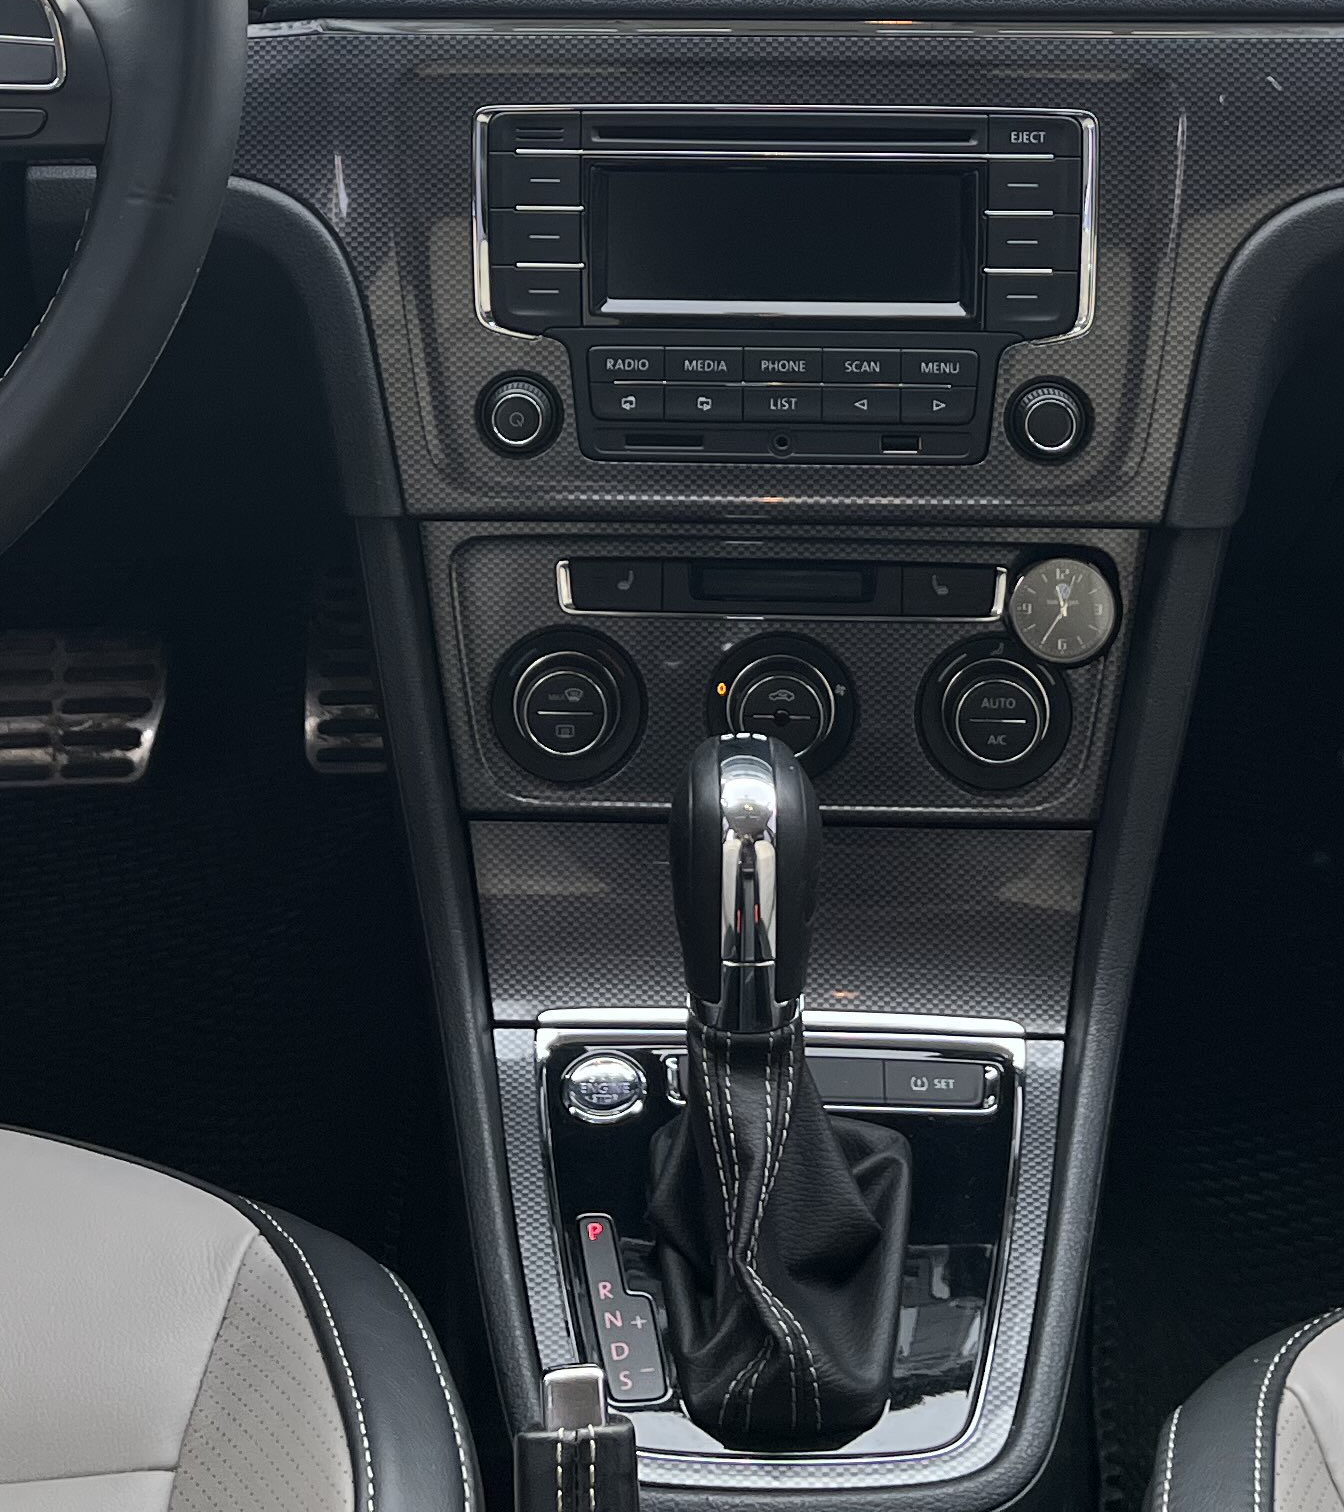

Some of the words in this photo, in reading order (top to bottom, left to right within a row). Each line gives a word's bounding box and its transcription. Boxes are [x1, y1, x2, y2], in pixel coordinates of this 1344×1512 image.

[1010, 131, 1046, 144] EJECT
[606, 358, 649, 371] RADIO
[684, 360, 728, 373] MEDIA
[760, 360, 806, 373] PHONE
[844, 361, 881, 374] SCAN
[920, 361, 960, 374] MENU
[770, 398, 798, 411] LIST
[981, 697, 1016, 709] AUTO
[987, 734, 1007, 745] A/C
[933, 1078, 955, 1089] SET
[587, 1222, 602, 1240] P
[598, 1281, 614, 1300] R
[604, 1310, 622, 1329] N
[610, 1342, 629, 1361] D
[619, 1370, 632, 1390] S
